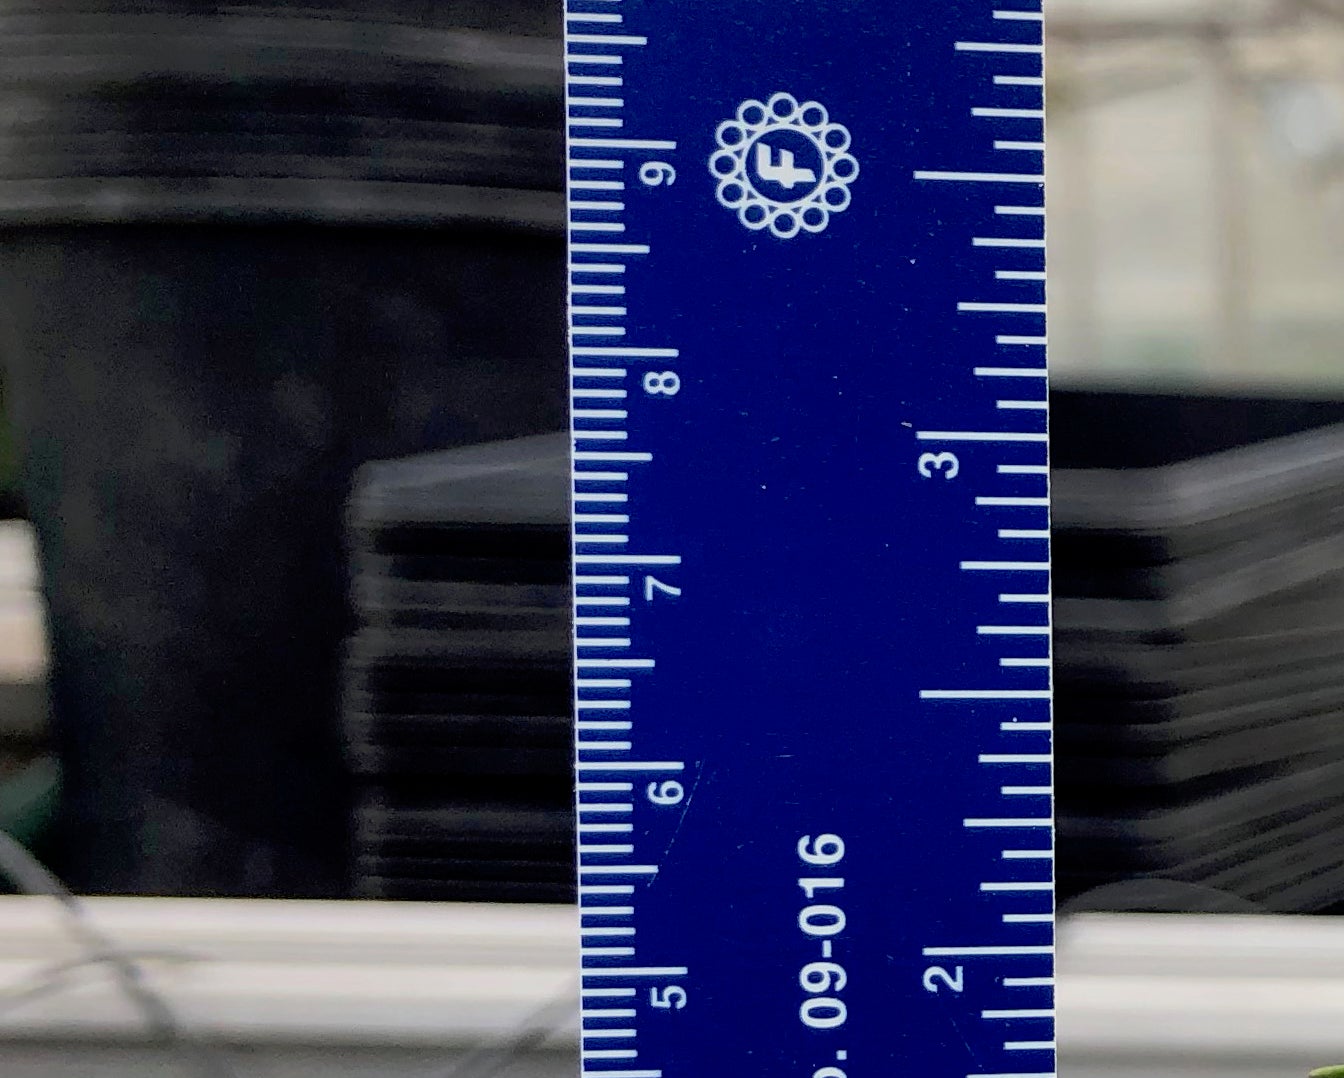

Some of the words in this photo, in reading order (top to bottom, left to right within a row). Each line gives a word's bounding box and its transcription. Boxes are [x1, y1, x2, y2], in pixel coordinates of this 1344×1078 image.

[639, 160, 676, 187] 9
[643, 370, 681, 396] 8
[917, 451, 960, 479] 3
[645, 575, 682, 601] 7
[647, 780, 684, 805] 6
[797, 833, 848, 1029] 09-016
[923, 965, 964, 993] 2
[650, 985, 687, 1010] 5
